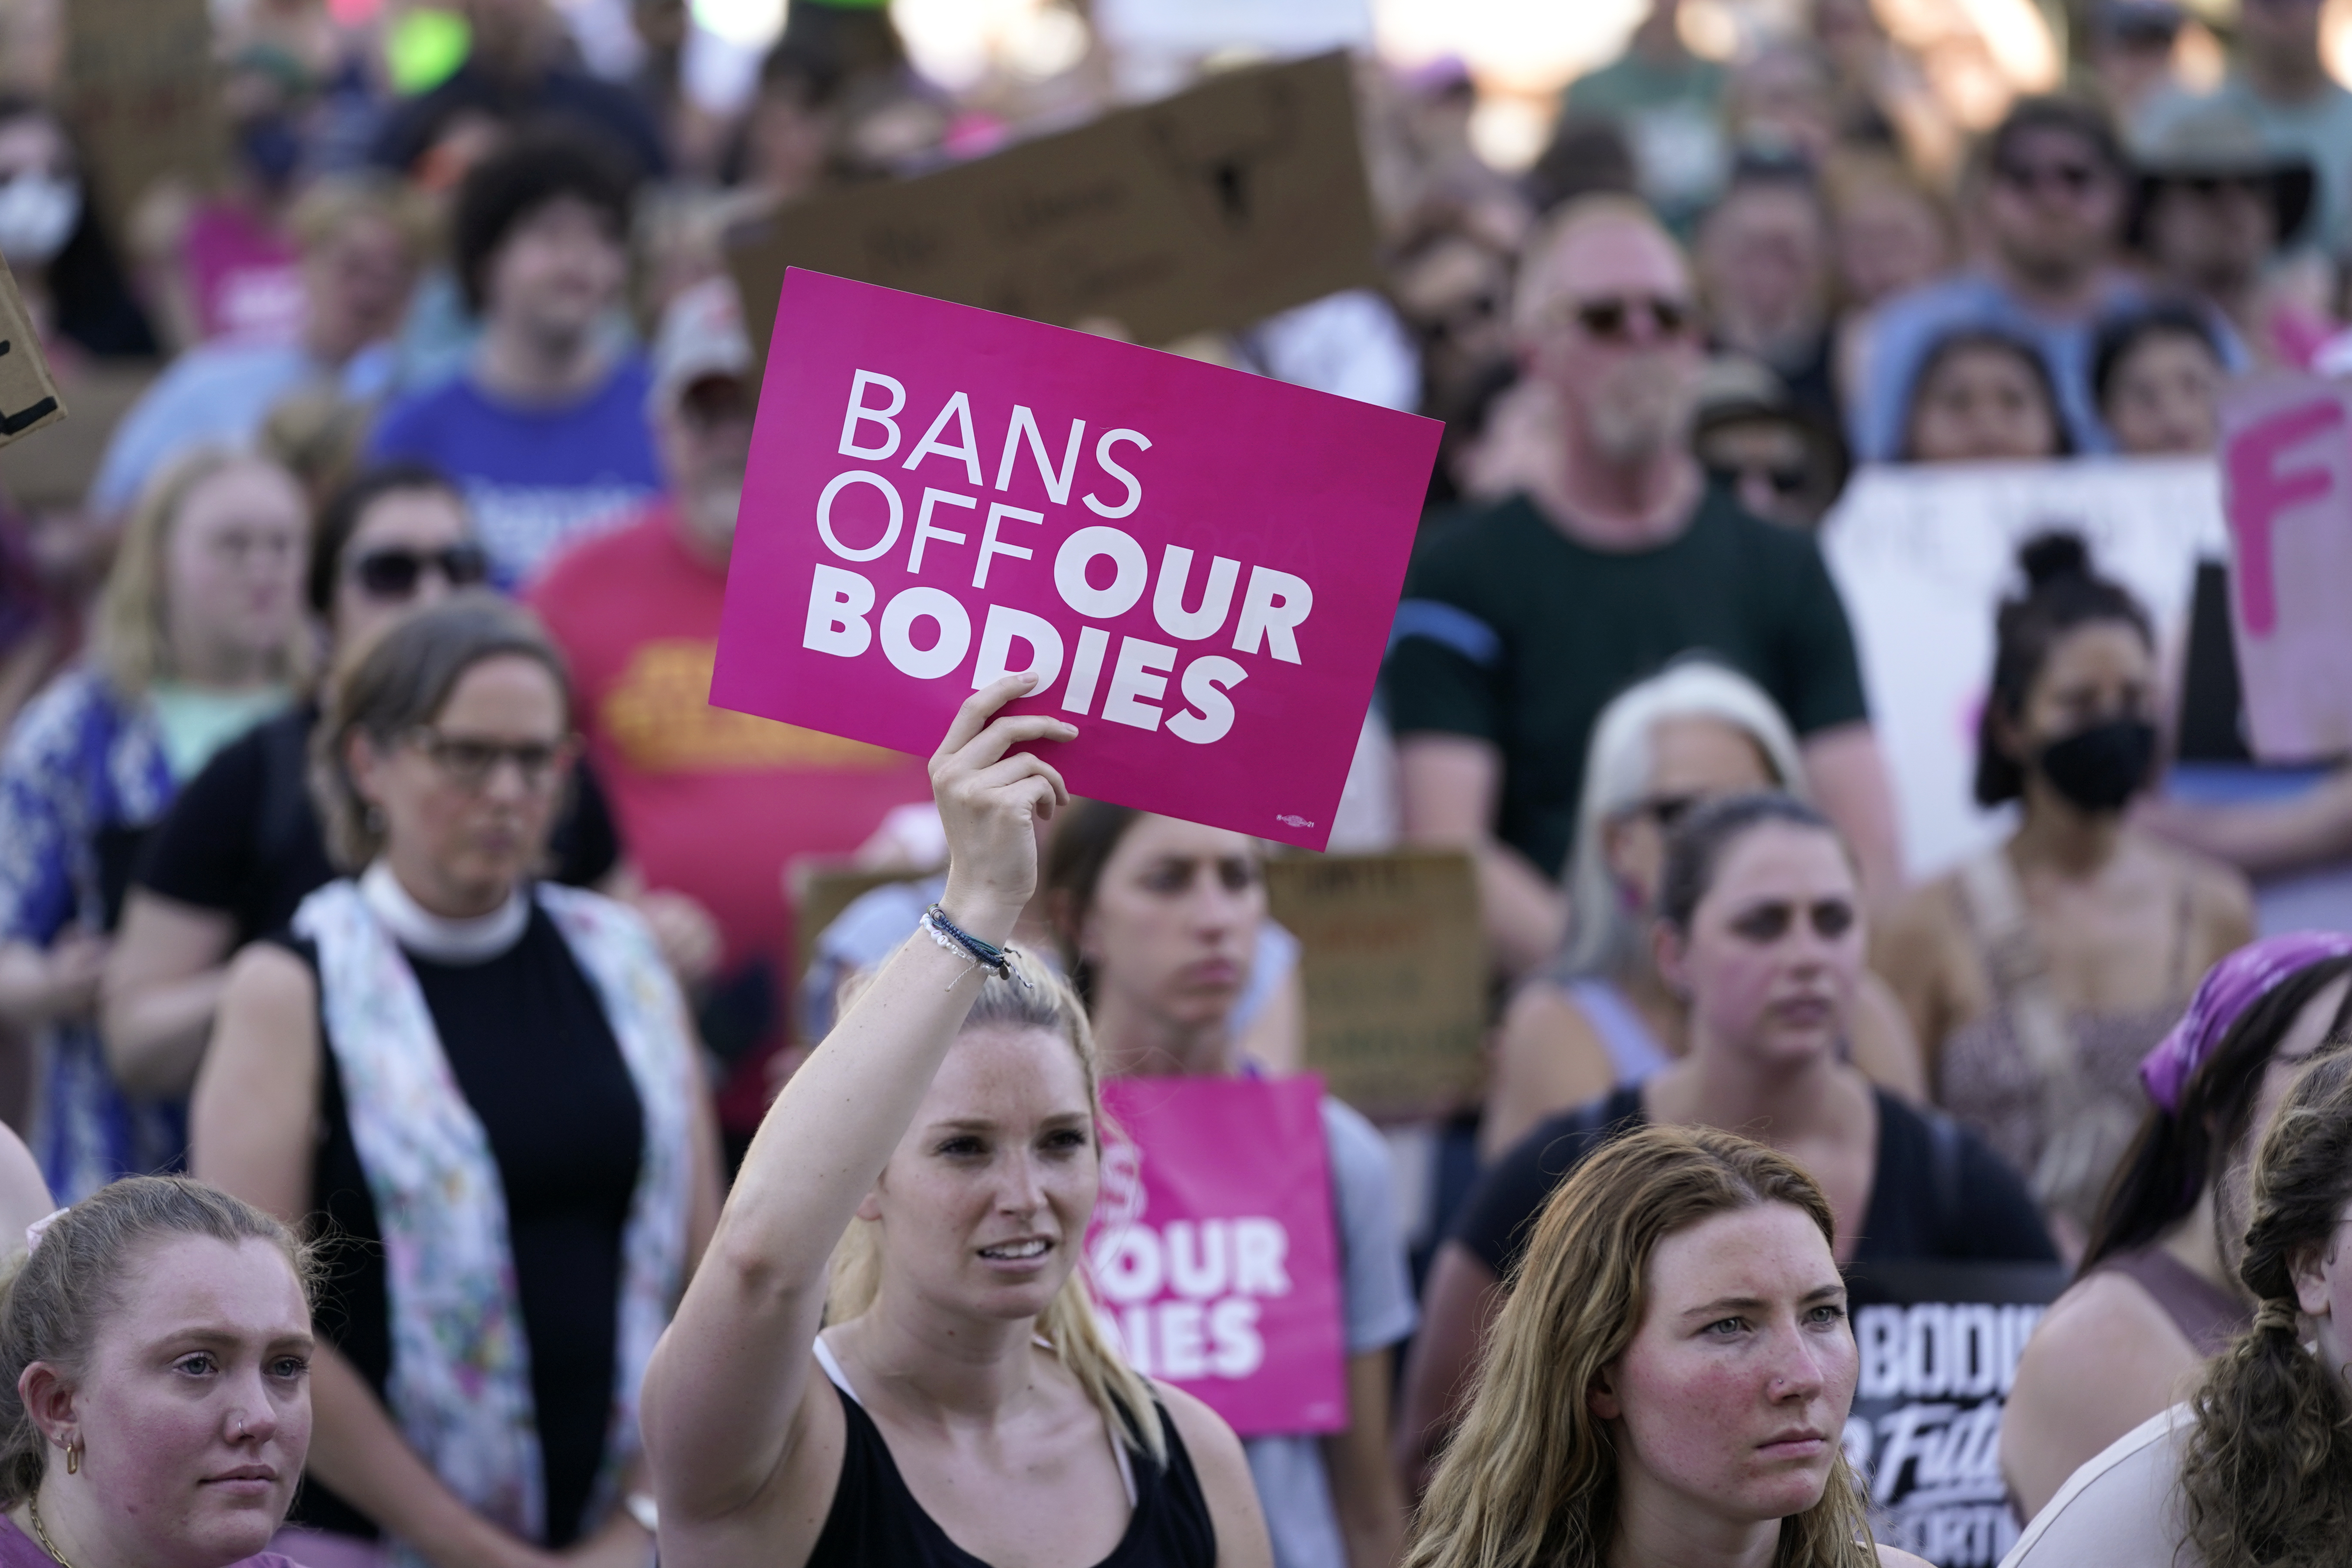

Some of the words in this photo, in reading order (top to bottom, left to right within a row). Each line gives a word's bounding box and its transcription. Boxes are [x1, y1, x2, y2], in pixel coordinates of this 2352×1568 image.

[838, 369, 1152, 519] BANS
[817, 471, 1044, 589] OFF
[1054, 526, 1313, 665] OUR
[803, 563, 1248, 744] BODIES
[1092, 1218, 1291, 1303] OUR
